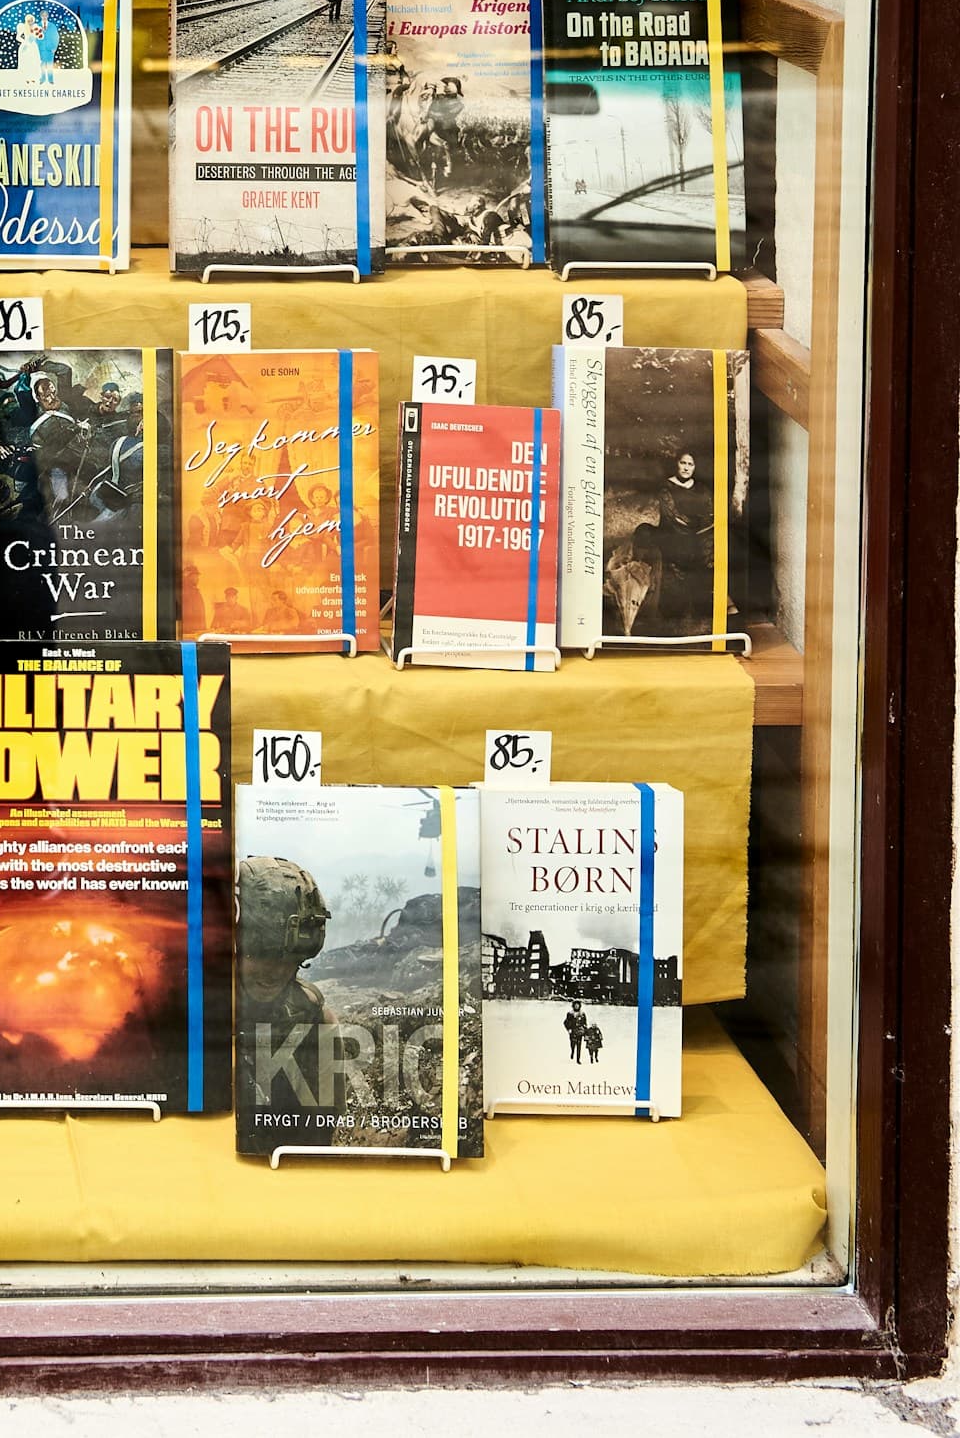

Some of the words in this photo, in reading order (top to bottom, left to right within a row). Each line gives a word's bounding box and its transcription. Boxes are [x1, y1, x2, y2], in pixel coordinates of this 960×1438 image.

[398, 21, 468, 39] Europas
[567, 12, 594, 37] On
[599, 11, 634, 37] the
[638, 11, 690, 37] Road
[600, 41, 621, 67] to
[13, 89, 49, 98] SKESLIEN
[52, 89, 86, 98] CHARLES
[195, 106, 233, 153] ON
[244, 106, 301, 153] THE
[197, 166, 256, 179] DESERTERS
[261, 166, 310, 179] THROUGH
[315, 166, 334, 179] THE
[242, 191, 288, 209] GRAEME
[291, 191, 321, 209] KENT
[261, 367, 276, 377] OLE
[278, 367, 300, 377] SOHN
[581, 358, 603, 427] Skyggen
[580, 479, 601, 517] glad
[59, 524, 96, 540] The
[4, 540, 143, 571] Crimean
[584, 523, 600, 576] verden
[42, 572, 116, 602] War
[42, 648, 62, 658] East
[71, 648, 96, 658] West
[17, 659, 41, 672] THE
[43, 659, 103, 672] BALANCE
[105, 659, 122, 672] OF
[29, 840, 91, 853] alliances
[94, 841, 155, 854] confront
[31, 858, 54, 872] the
[57, 859, 93, 872] most
[96, 859, 177, 872] destructive
[10, 877, 34, 890] the
[36, 877, 77, 890] world
[80, 877, 107, 890] has
[109, 879, 141, 890] ever
[142, 877, 188, 890] known
[530, 865, 636, 894] BØRN
[510, 902, 523, 911] Tre
[525, 902, 578, 912] generationer
[586, 902, 602, 912] krig
[604, 904, 615, 913] og
[371, 1006, 424, 1017] SEBASTIAN
[517, 1079, 561, 1095] Owen
[254, 1113, 300, 1128] FRYGT
[316, 1114, 355, 1129] DRAB
